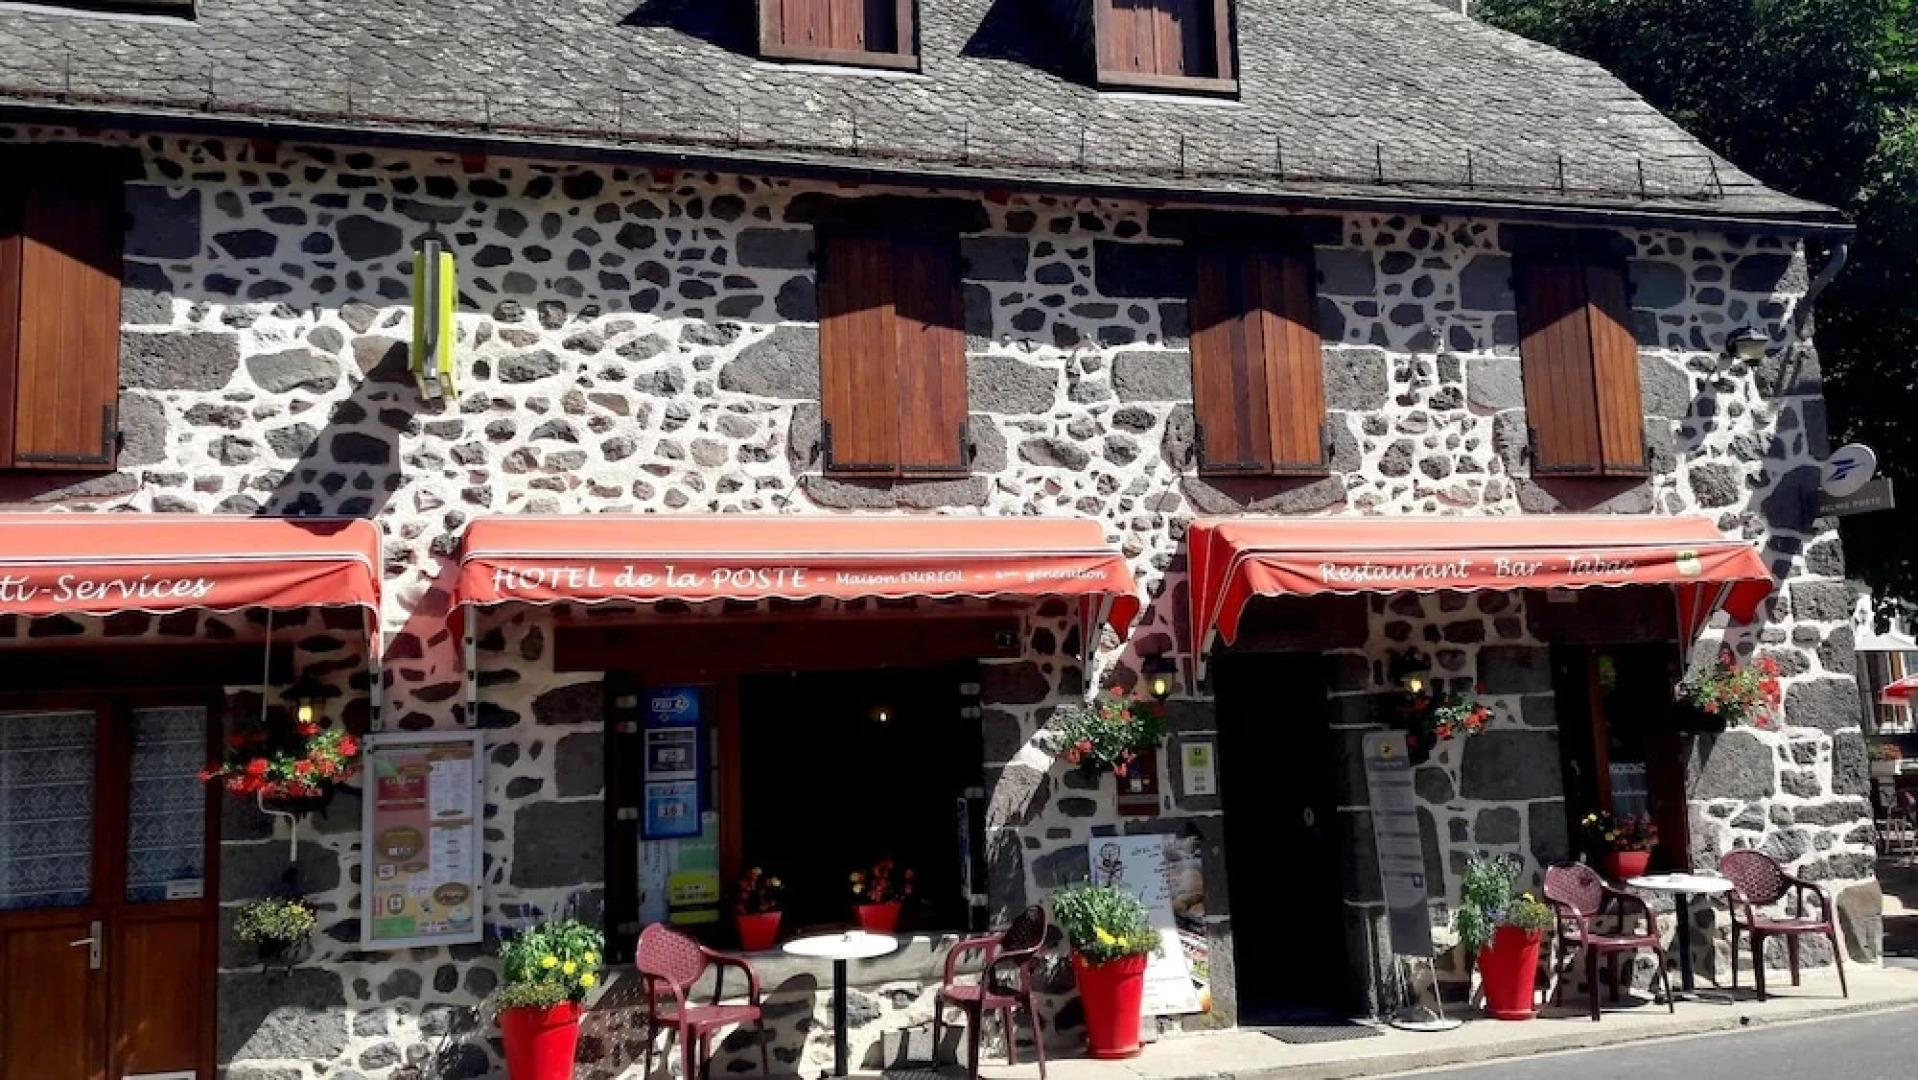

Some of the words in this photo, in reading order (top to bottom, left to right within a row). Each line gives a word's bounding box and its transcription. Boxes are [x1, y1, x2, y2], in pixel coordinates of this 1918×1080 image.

[492, 564, 604, 591] HOTEL
[613, 565, 660, 588] de
[665, 565, 707, 588] la
[710, 564, 808, 589] POSTE
[836, 571, 899, 585] Maison
[1319, 557, 1473, 583] Restaurant
[1493, 557, 1543, 578] Bar
[1564, 555, 1636, 577] Tabac
